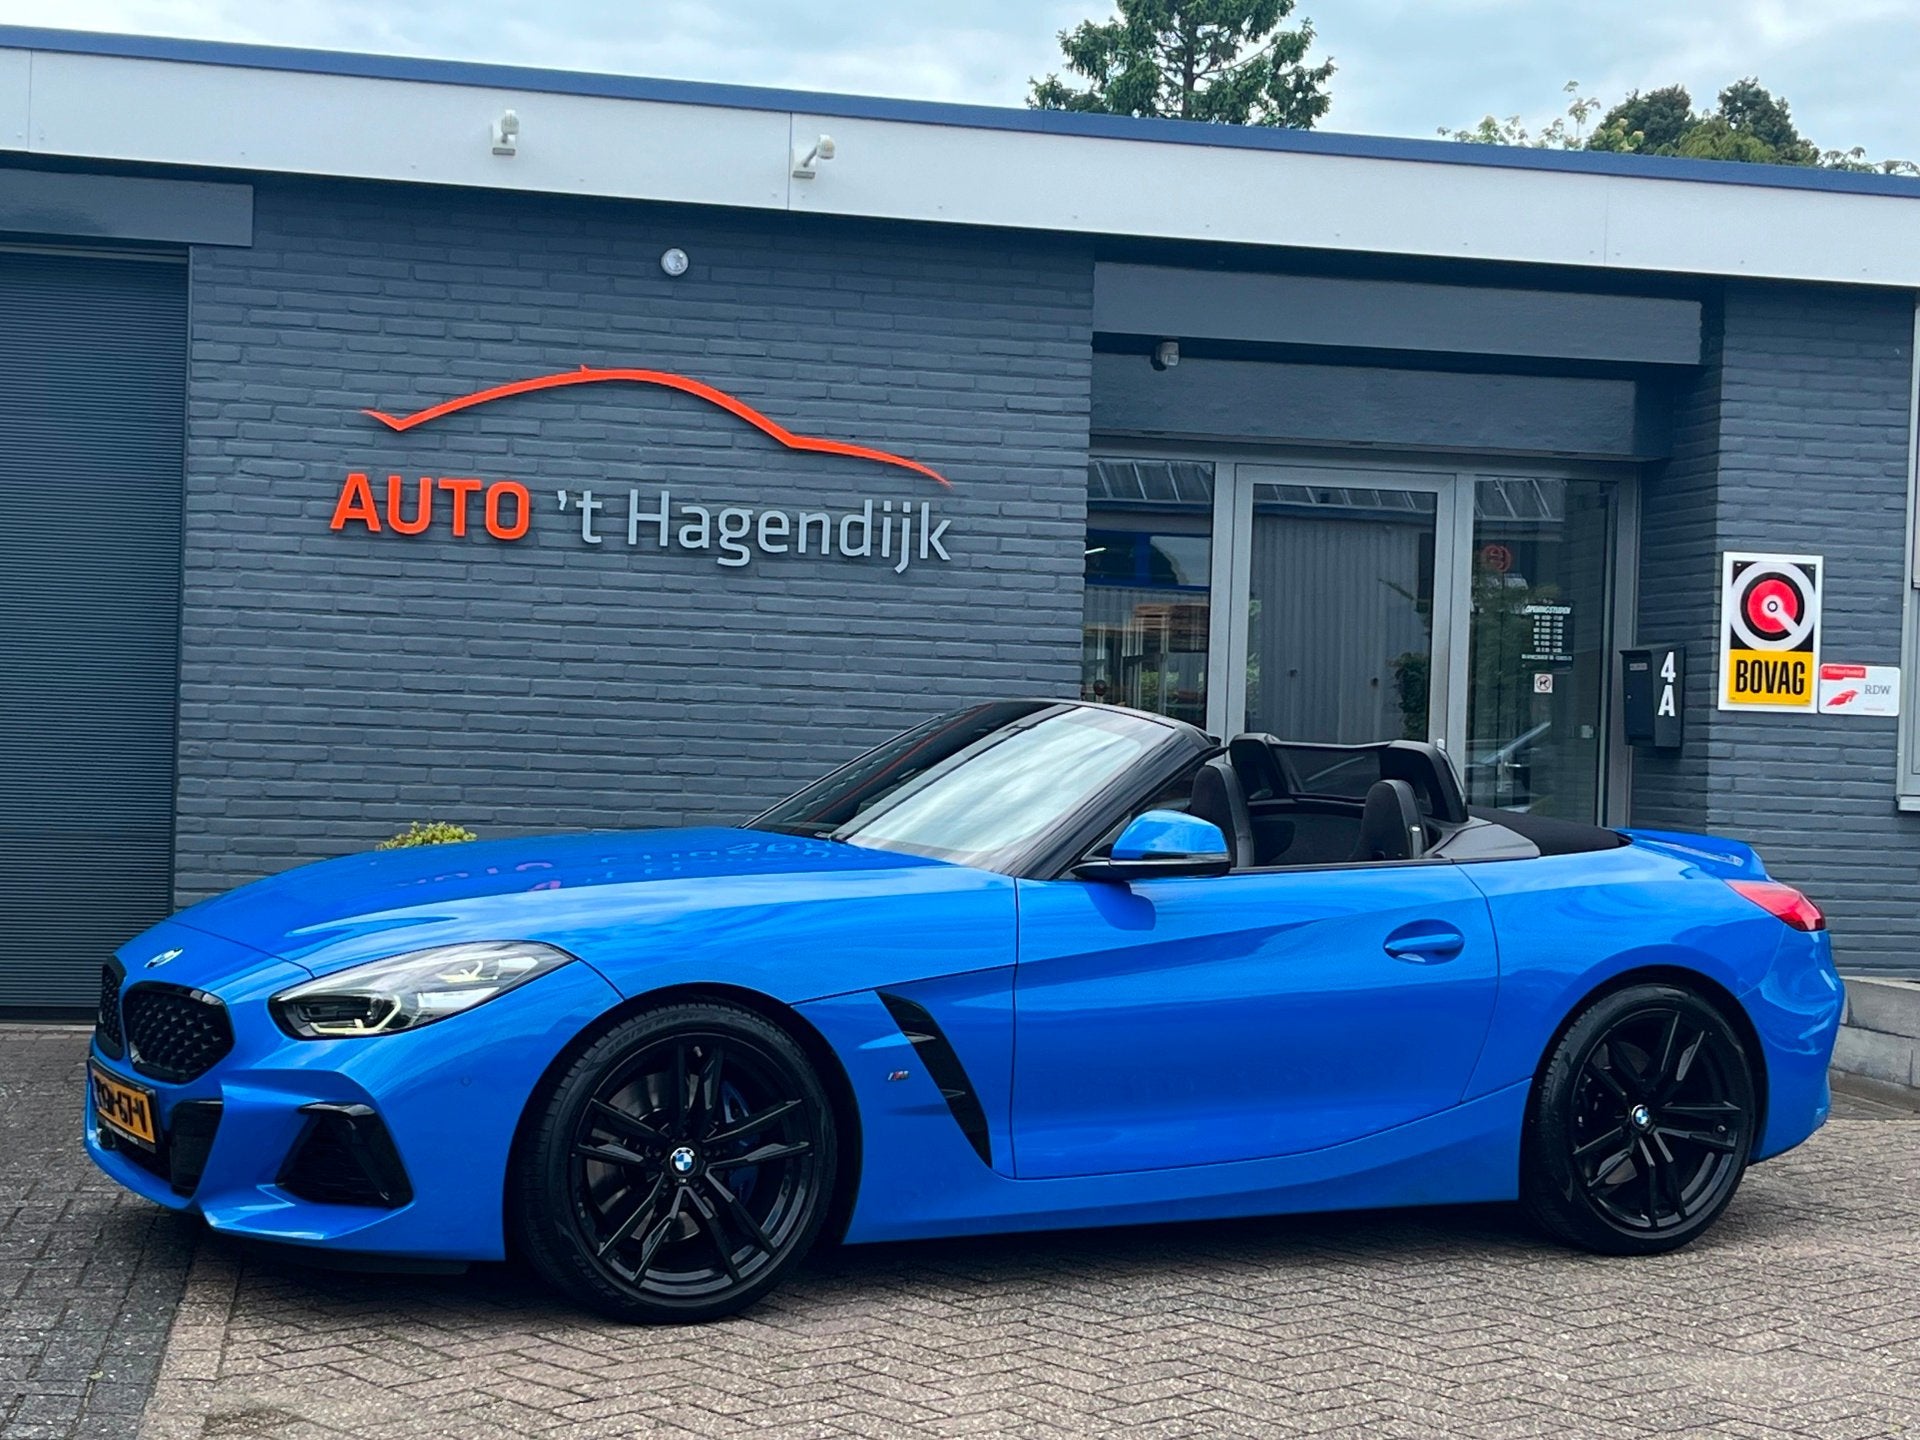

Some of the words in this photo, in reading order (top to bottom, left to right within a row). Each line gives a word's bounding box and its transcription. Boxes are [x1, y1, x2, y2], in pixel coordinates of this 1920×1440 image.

[330, 473, 530, 540] AUTO
[627, 489, 951, 574] Hagendijk
[1735, 658, 1806, 696] BOVAG
[1864, 684, 1891, 695] RDW
